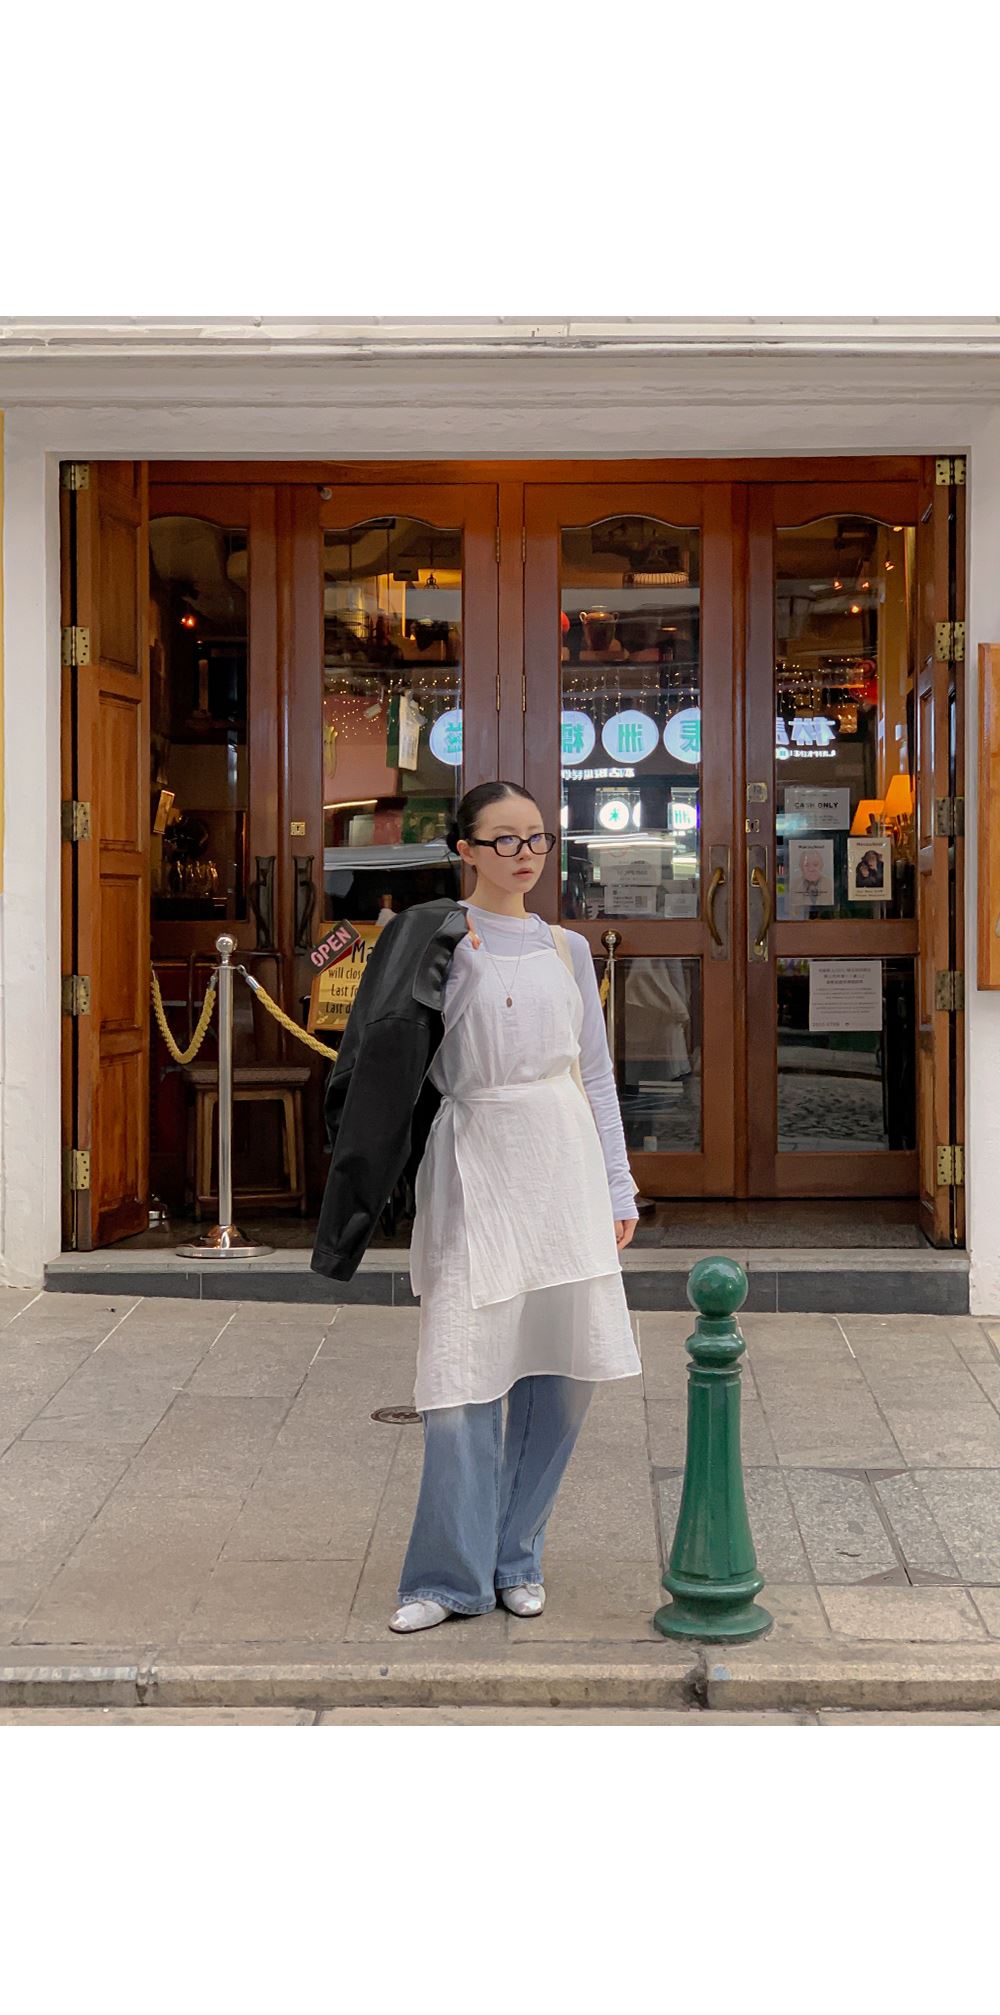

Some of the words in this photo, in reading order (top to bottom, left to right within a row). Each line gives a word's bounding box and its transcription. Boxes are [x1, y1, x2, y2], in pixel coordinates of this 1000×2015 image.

[310, 926, 352, 967] OPEN
[351, 939, 374, 963] Ma
[328, 967, 344, 979] will
[346, 967, 361, 980] clos
[331, 983, 349, 997] Last
[326, 1002, 343, 1015] Last
[345, 1003, 352, 1014] d
